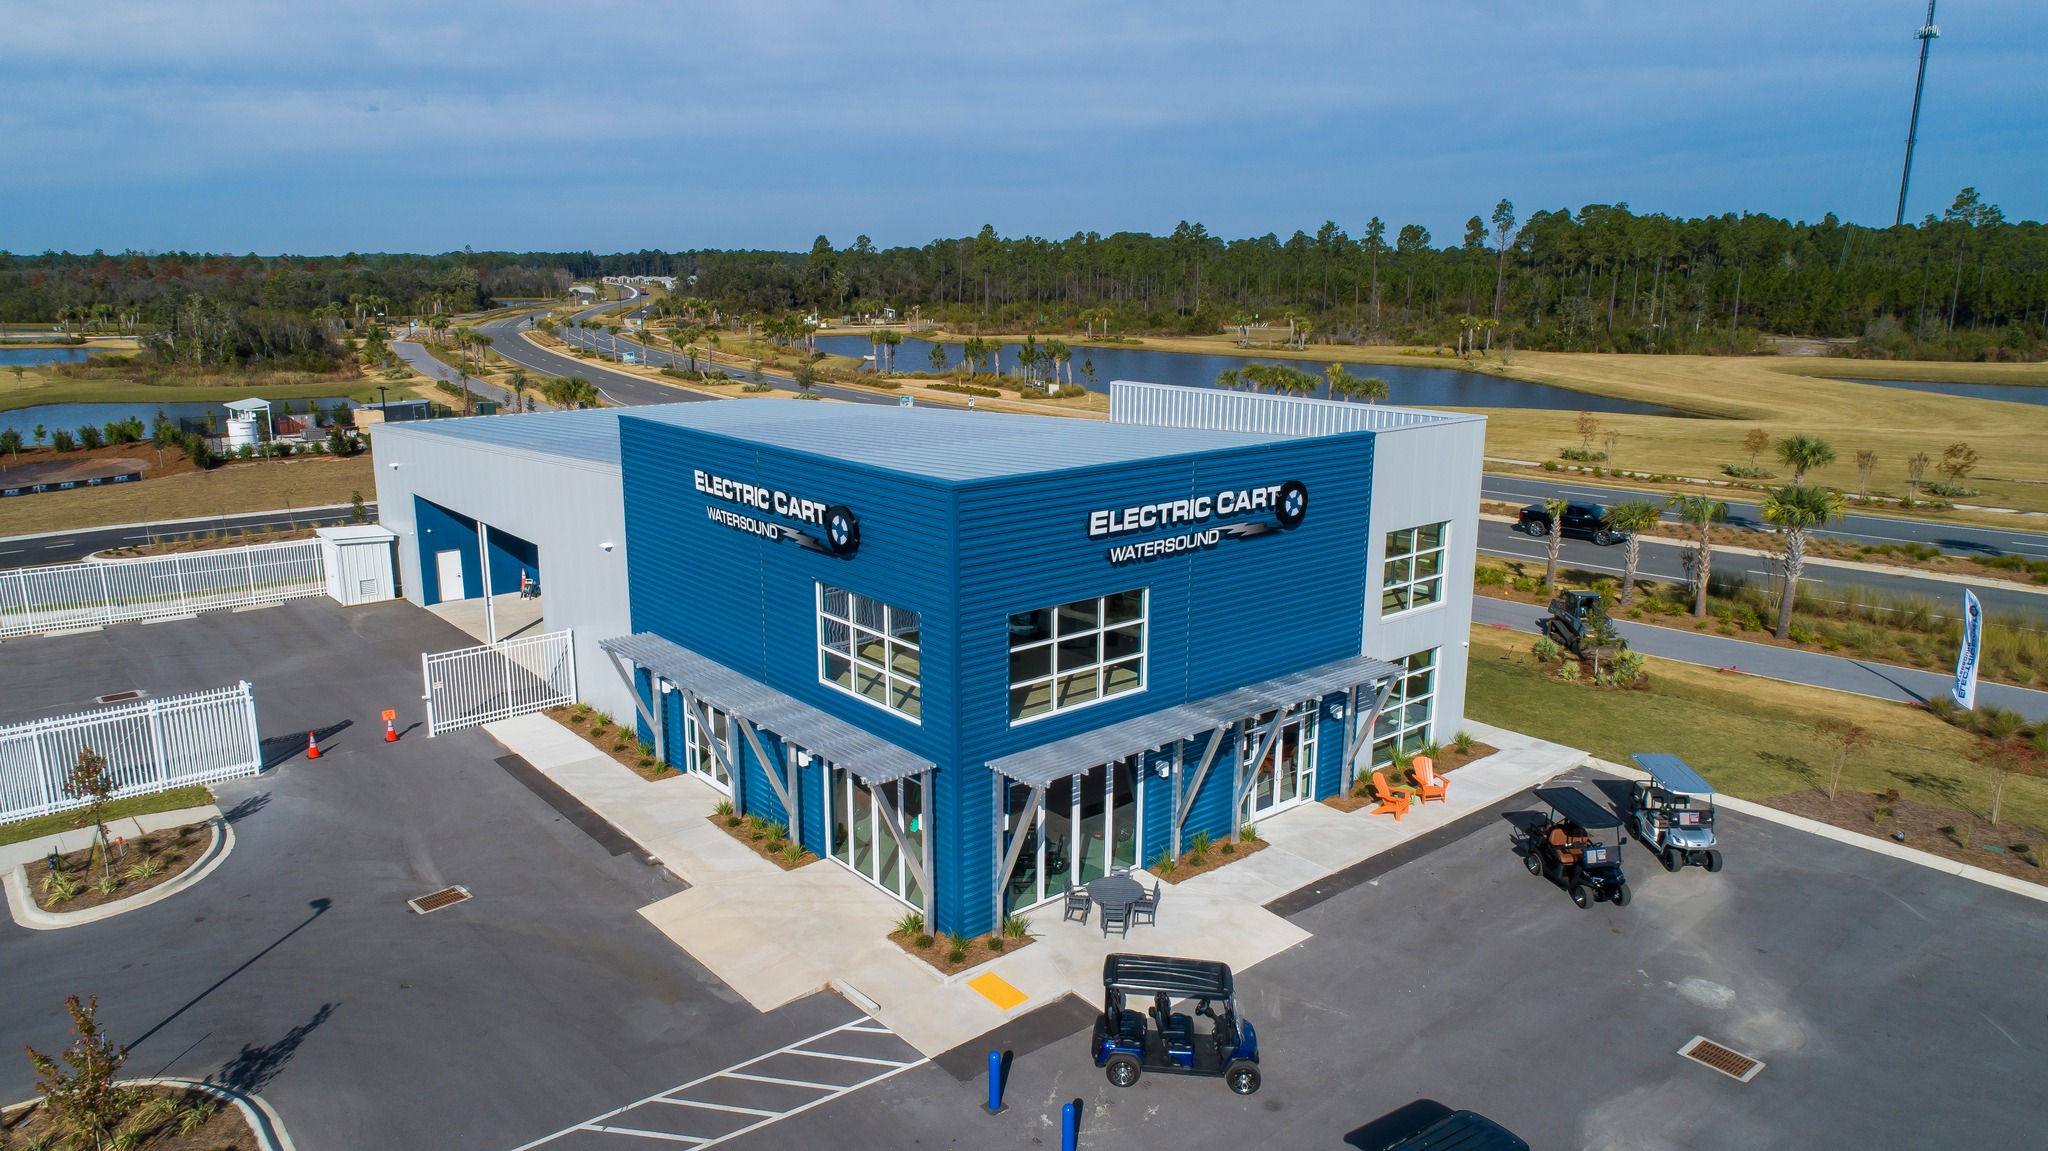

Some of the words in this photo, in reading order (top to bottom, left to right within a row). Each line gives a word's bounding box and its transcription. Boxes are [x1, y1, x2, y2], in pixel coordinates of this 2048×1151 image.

[694, 469, 770, 510] ELECTRIC
[774, 491, 826, 525] CART
[1089, 496, 1211, 536] ELECTRIC
[1216, 485, 1282, 515] CART
[706, 505, 778, 540] WATERSOUND
[1110, 529, 1220, 563] WATERSOUND
